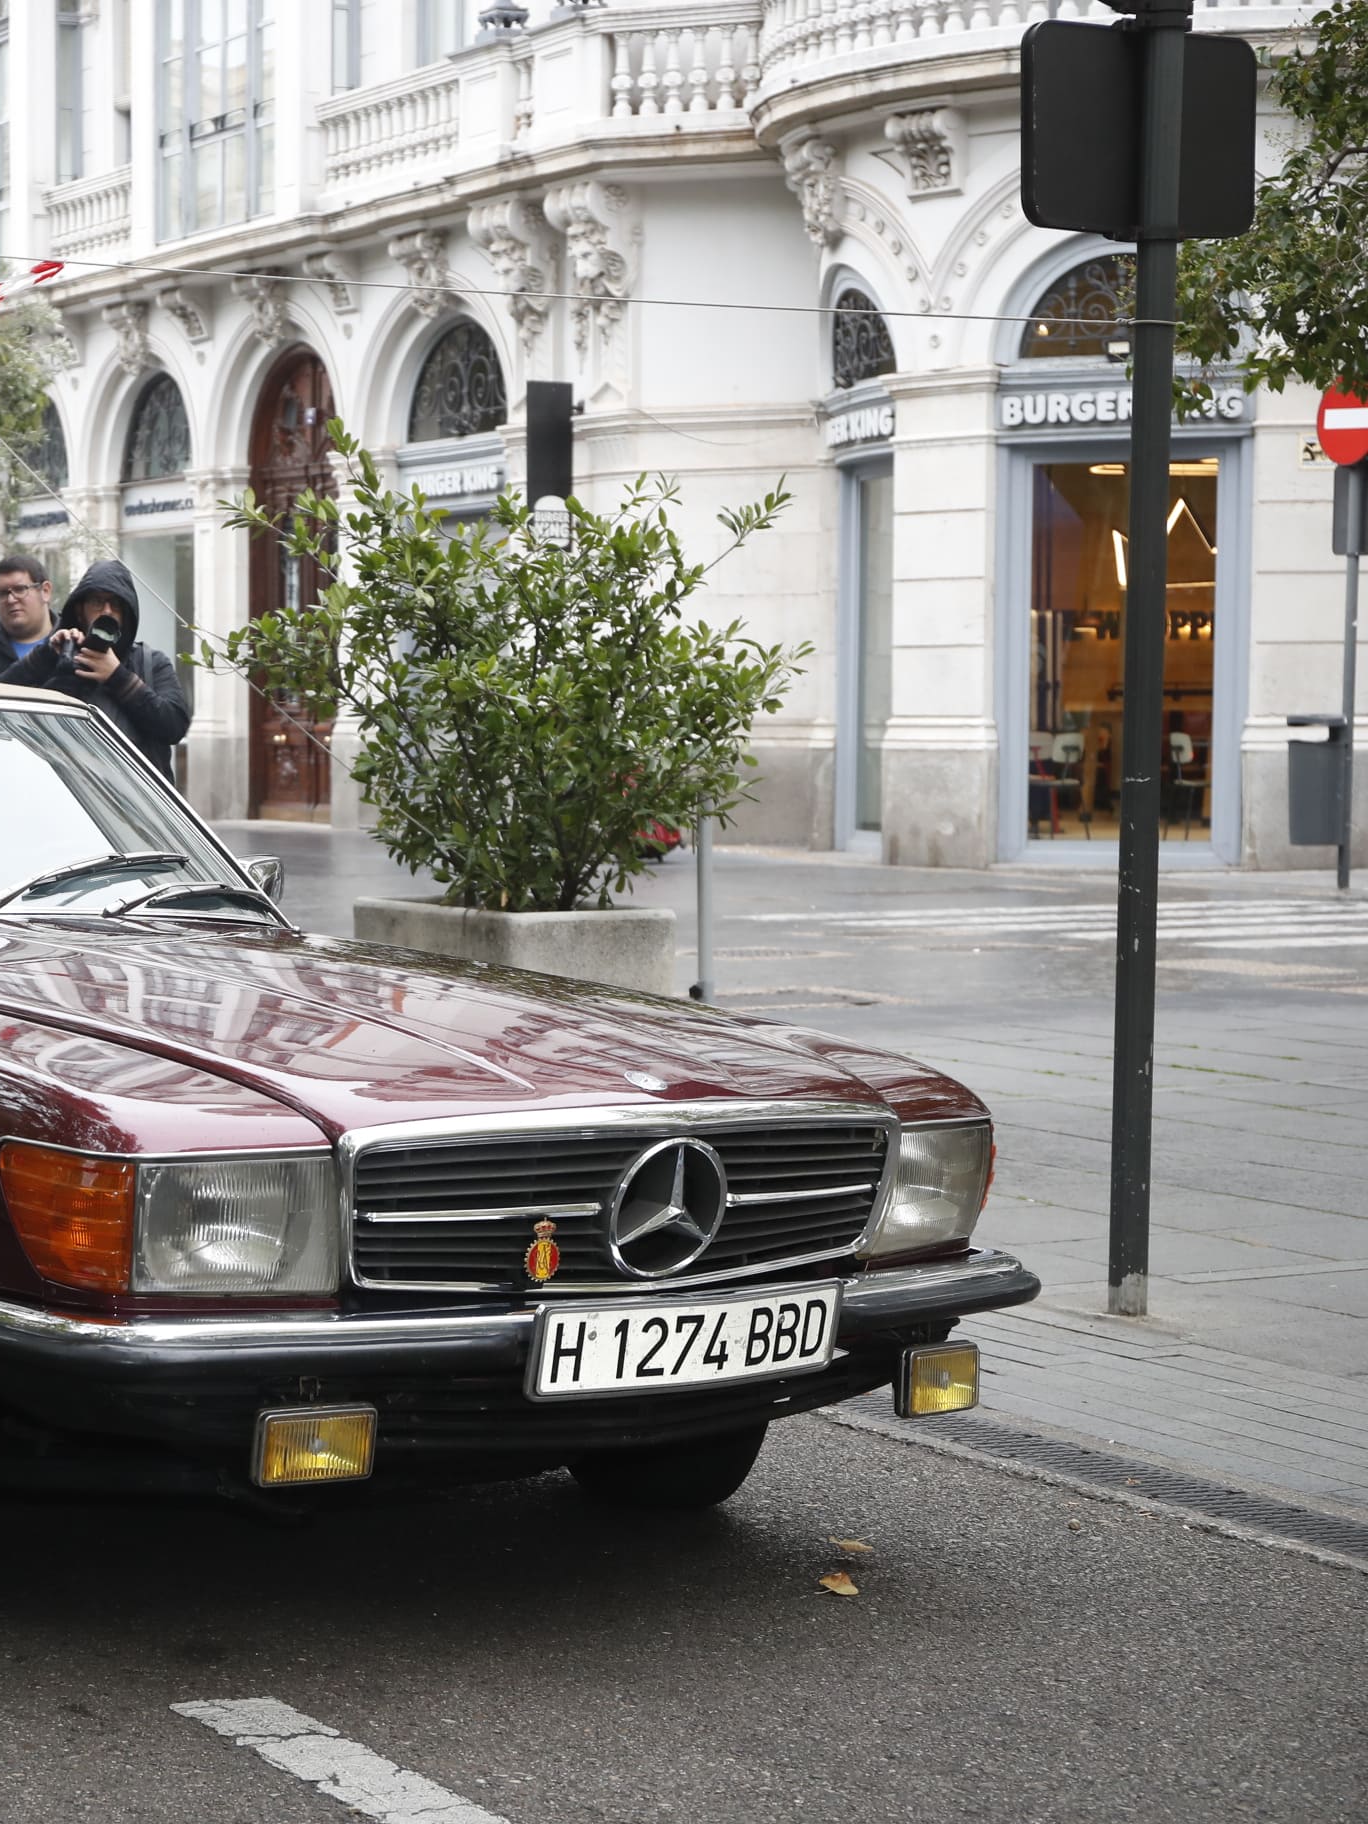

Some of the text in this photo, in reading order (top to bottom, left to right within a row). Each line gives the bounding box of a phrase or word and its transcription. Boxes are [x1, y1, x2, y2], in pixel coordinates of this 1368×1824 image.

[849, 407, 893, 440] KING
[463, 465, 498, 491] KING
[550, 1299, 827, 1383] H 1274 BBD
